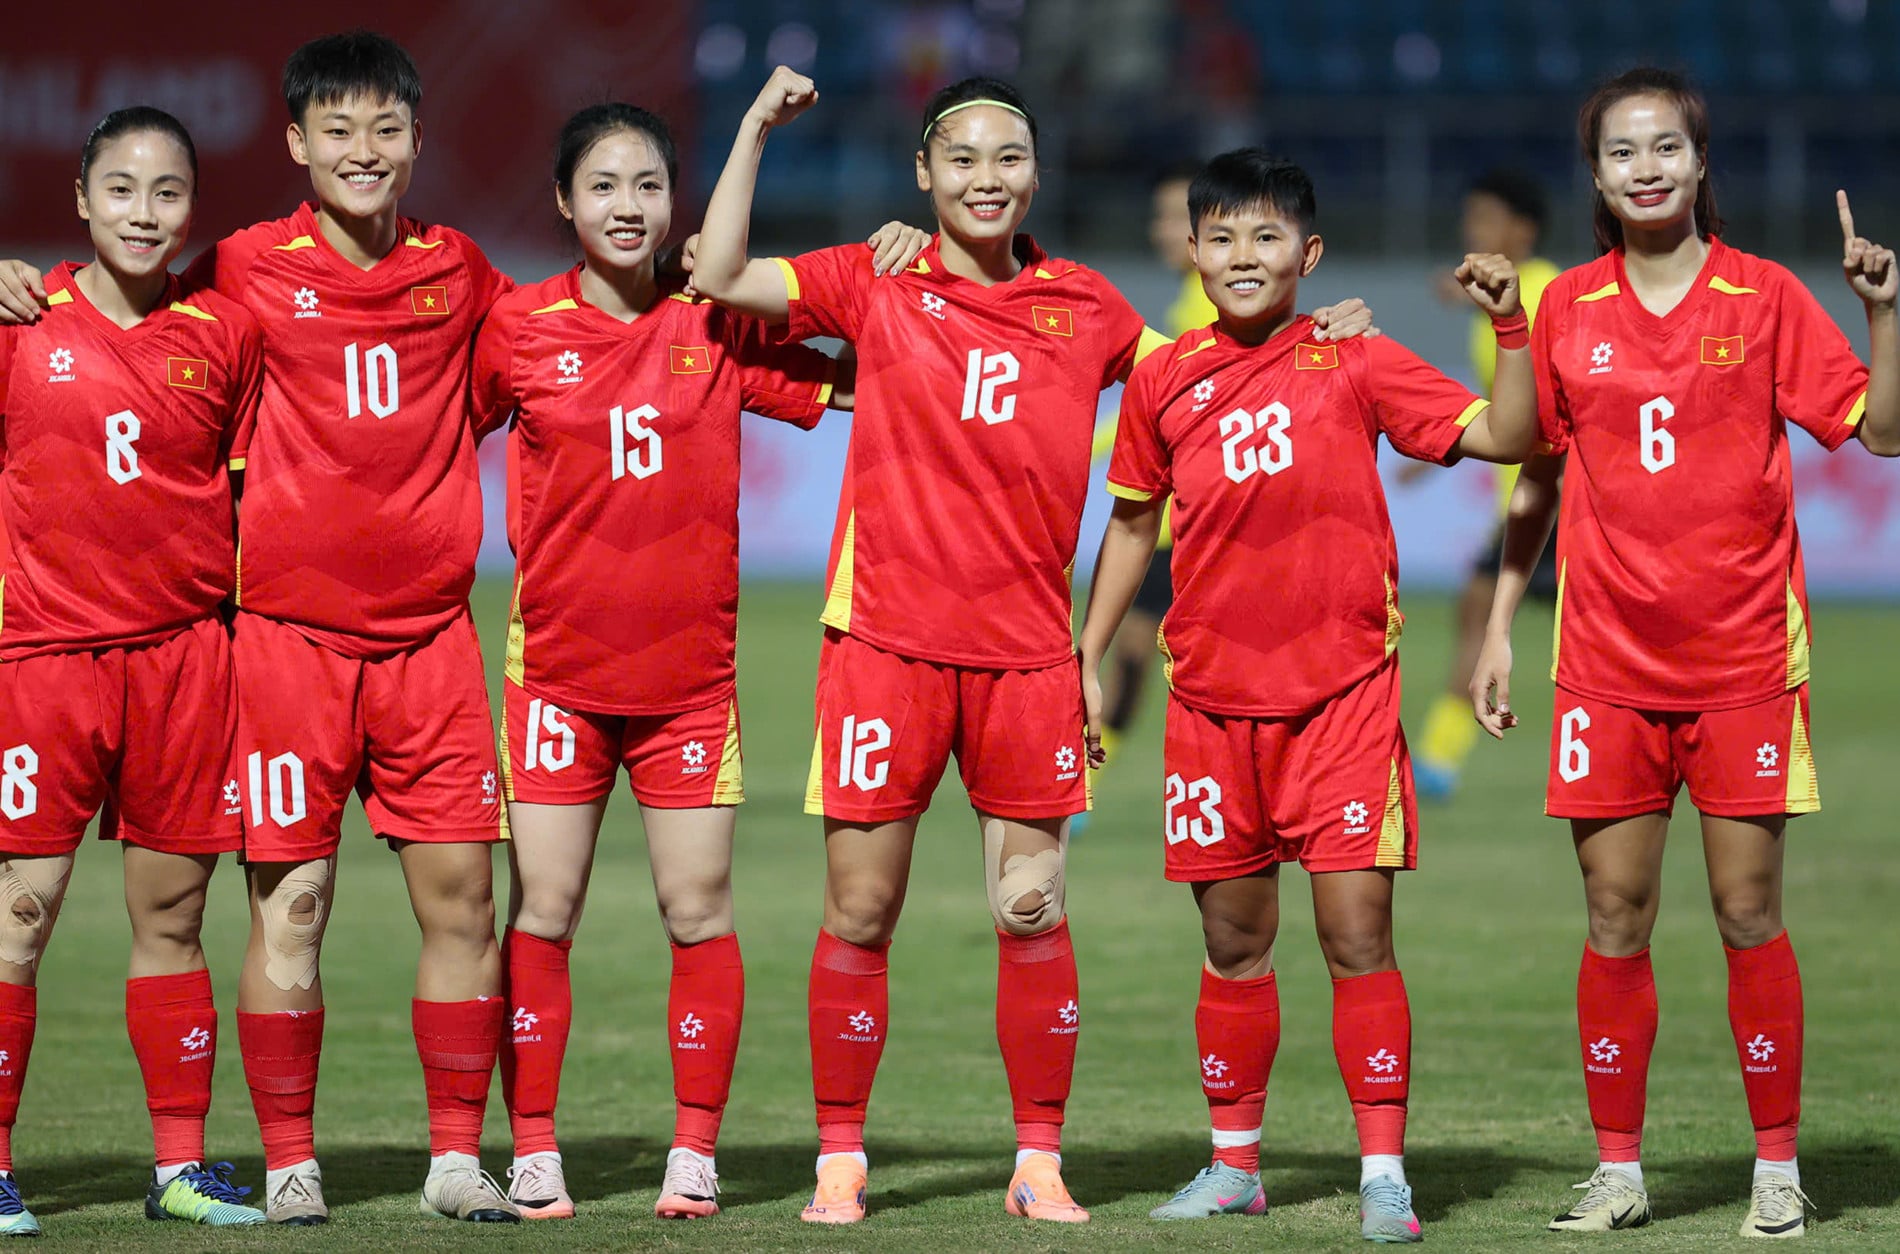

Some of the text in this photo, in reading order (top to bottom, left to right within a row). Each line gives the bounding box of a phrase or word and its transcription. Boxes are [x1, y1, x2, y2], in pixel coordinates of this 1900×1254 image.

[344, 342, 399, 420] 10
[960, 348, 1020, 425] 12
[105, 409, 143, 485] 8
[609, 404, 664, 481] 15
[1218, 401, 1294, 484] 23
[1639, 395, 1676, 475] 6
[524, 698, 577, 773] 15
[838, 714, 892, 793] 12
[1557, 706, 1592, 783] 6
[0, 743, 39, 822] 8
[247, 751, 308, 828] 10
[1165, 772, 1226, 849] 23
